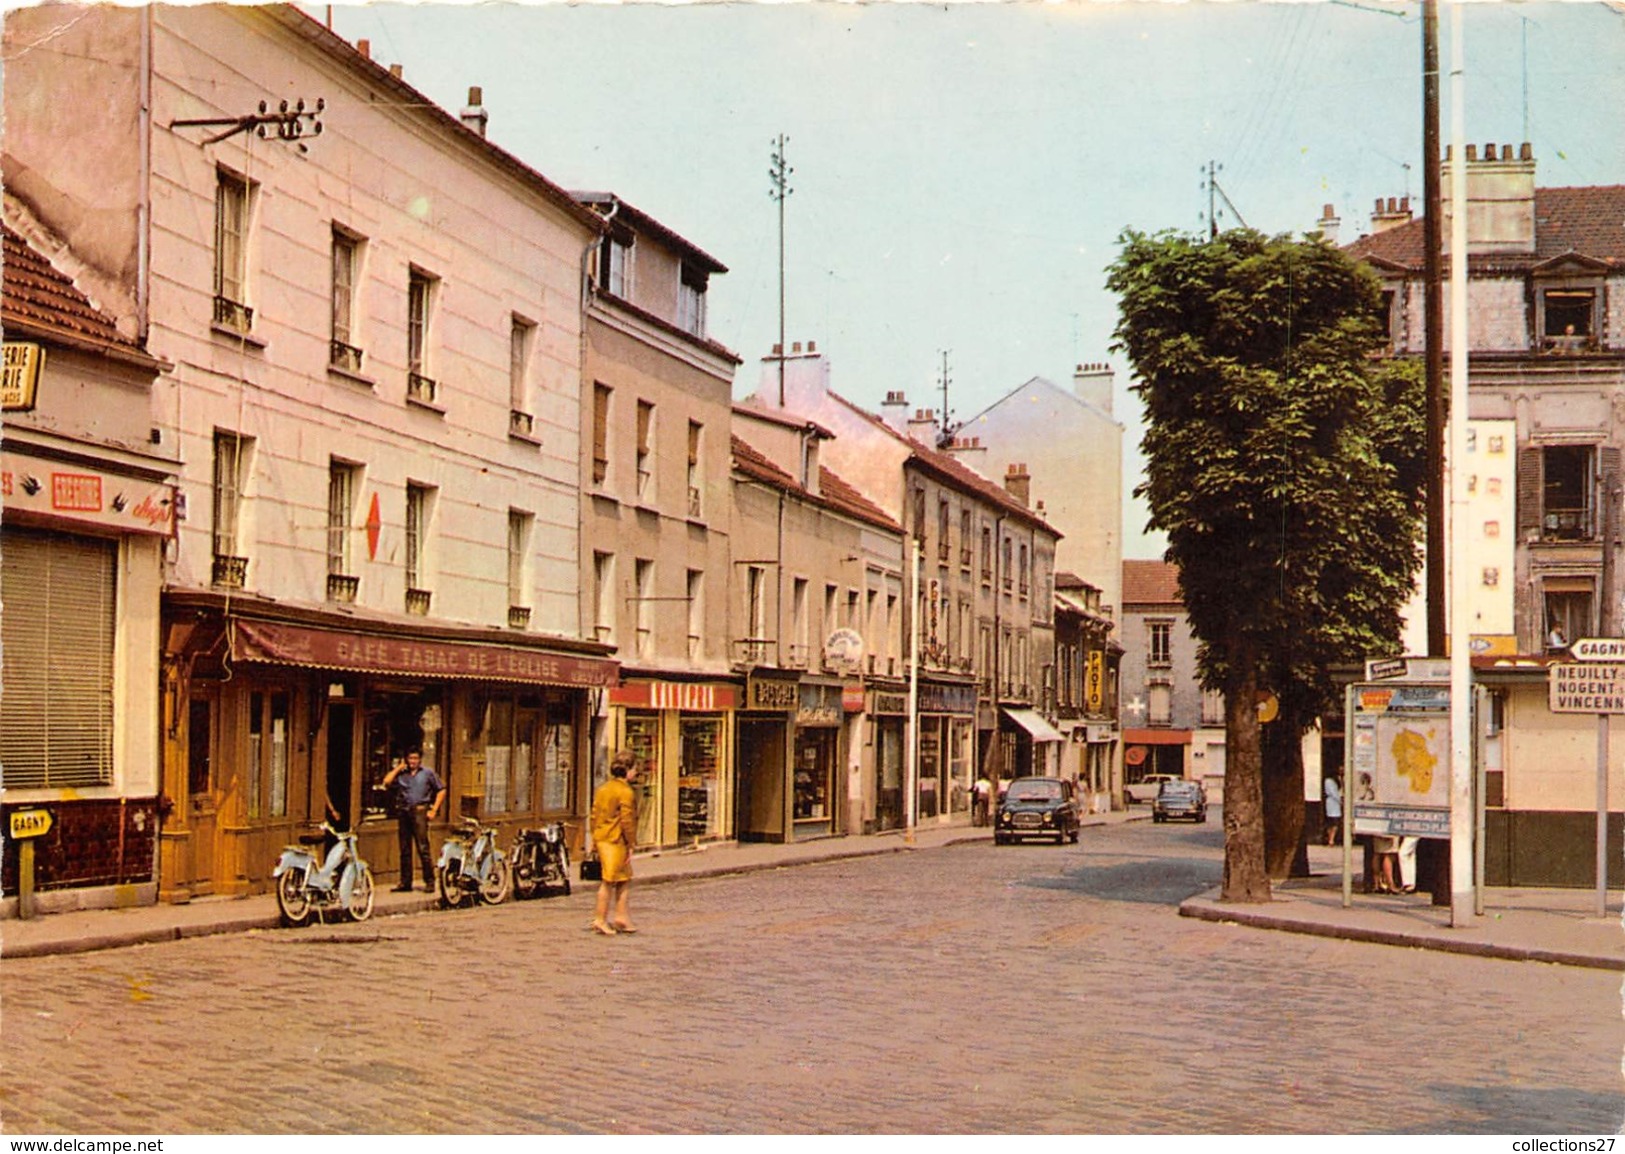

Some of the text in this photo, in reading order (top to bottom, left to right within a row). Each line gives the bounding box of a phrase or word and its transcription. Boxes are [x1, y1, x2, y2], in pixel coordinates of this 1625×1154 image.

[401, 647, 458, 668] TABAC
[468, 653, 488, 671] DE
[1091, 652, 1099, 704] PHOTO
[1558, 667, 1617, 679] NEUILLY
[1558, 682, 1615, 694] NOGENT
[13, 816, 45, 831] GAGNY
